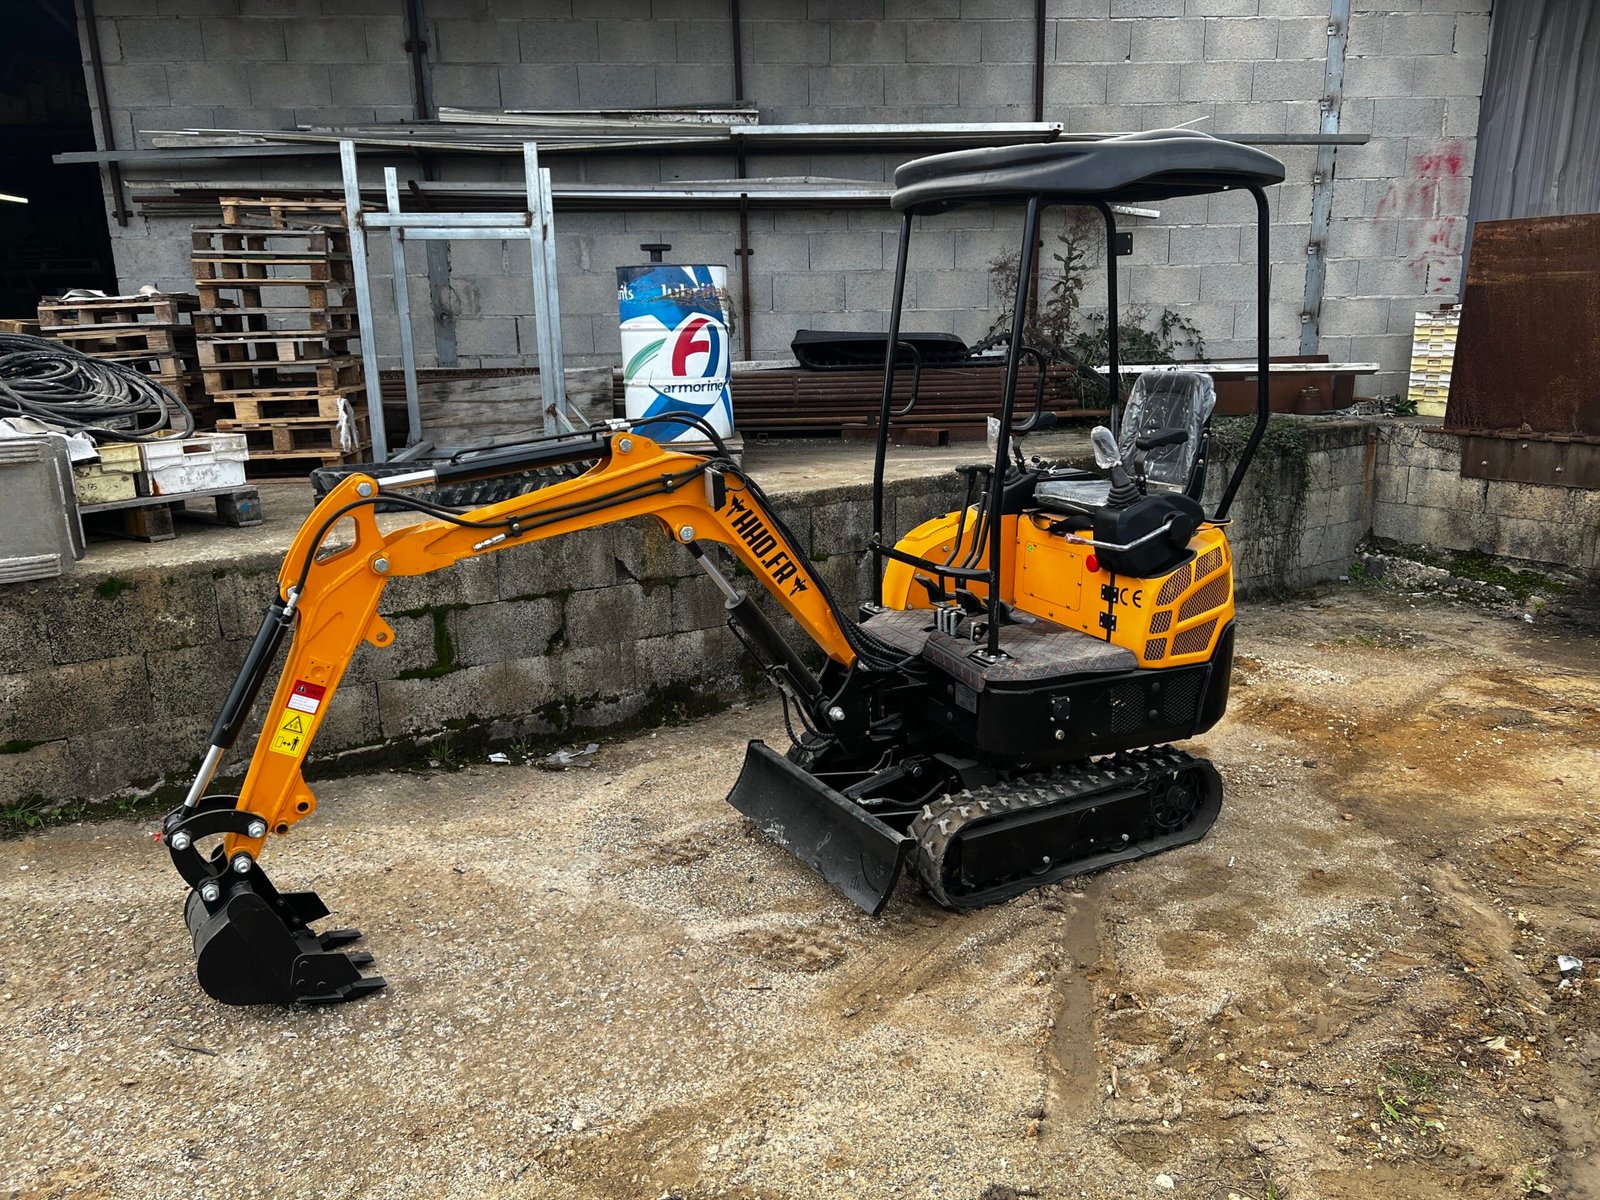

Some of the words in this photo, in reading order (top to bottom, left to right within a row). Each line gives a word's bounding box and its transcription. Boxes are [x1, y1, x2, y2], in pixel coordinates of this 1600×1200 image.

[663, 379, 723, 393] armorine
[731, 509, 798, 585] HHO.FR
[1120, 587, 1143, 608] CE
